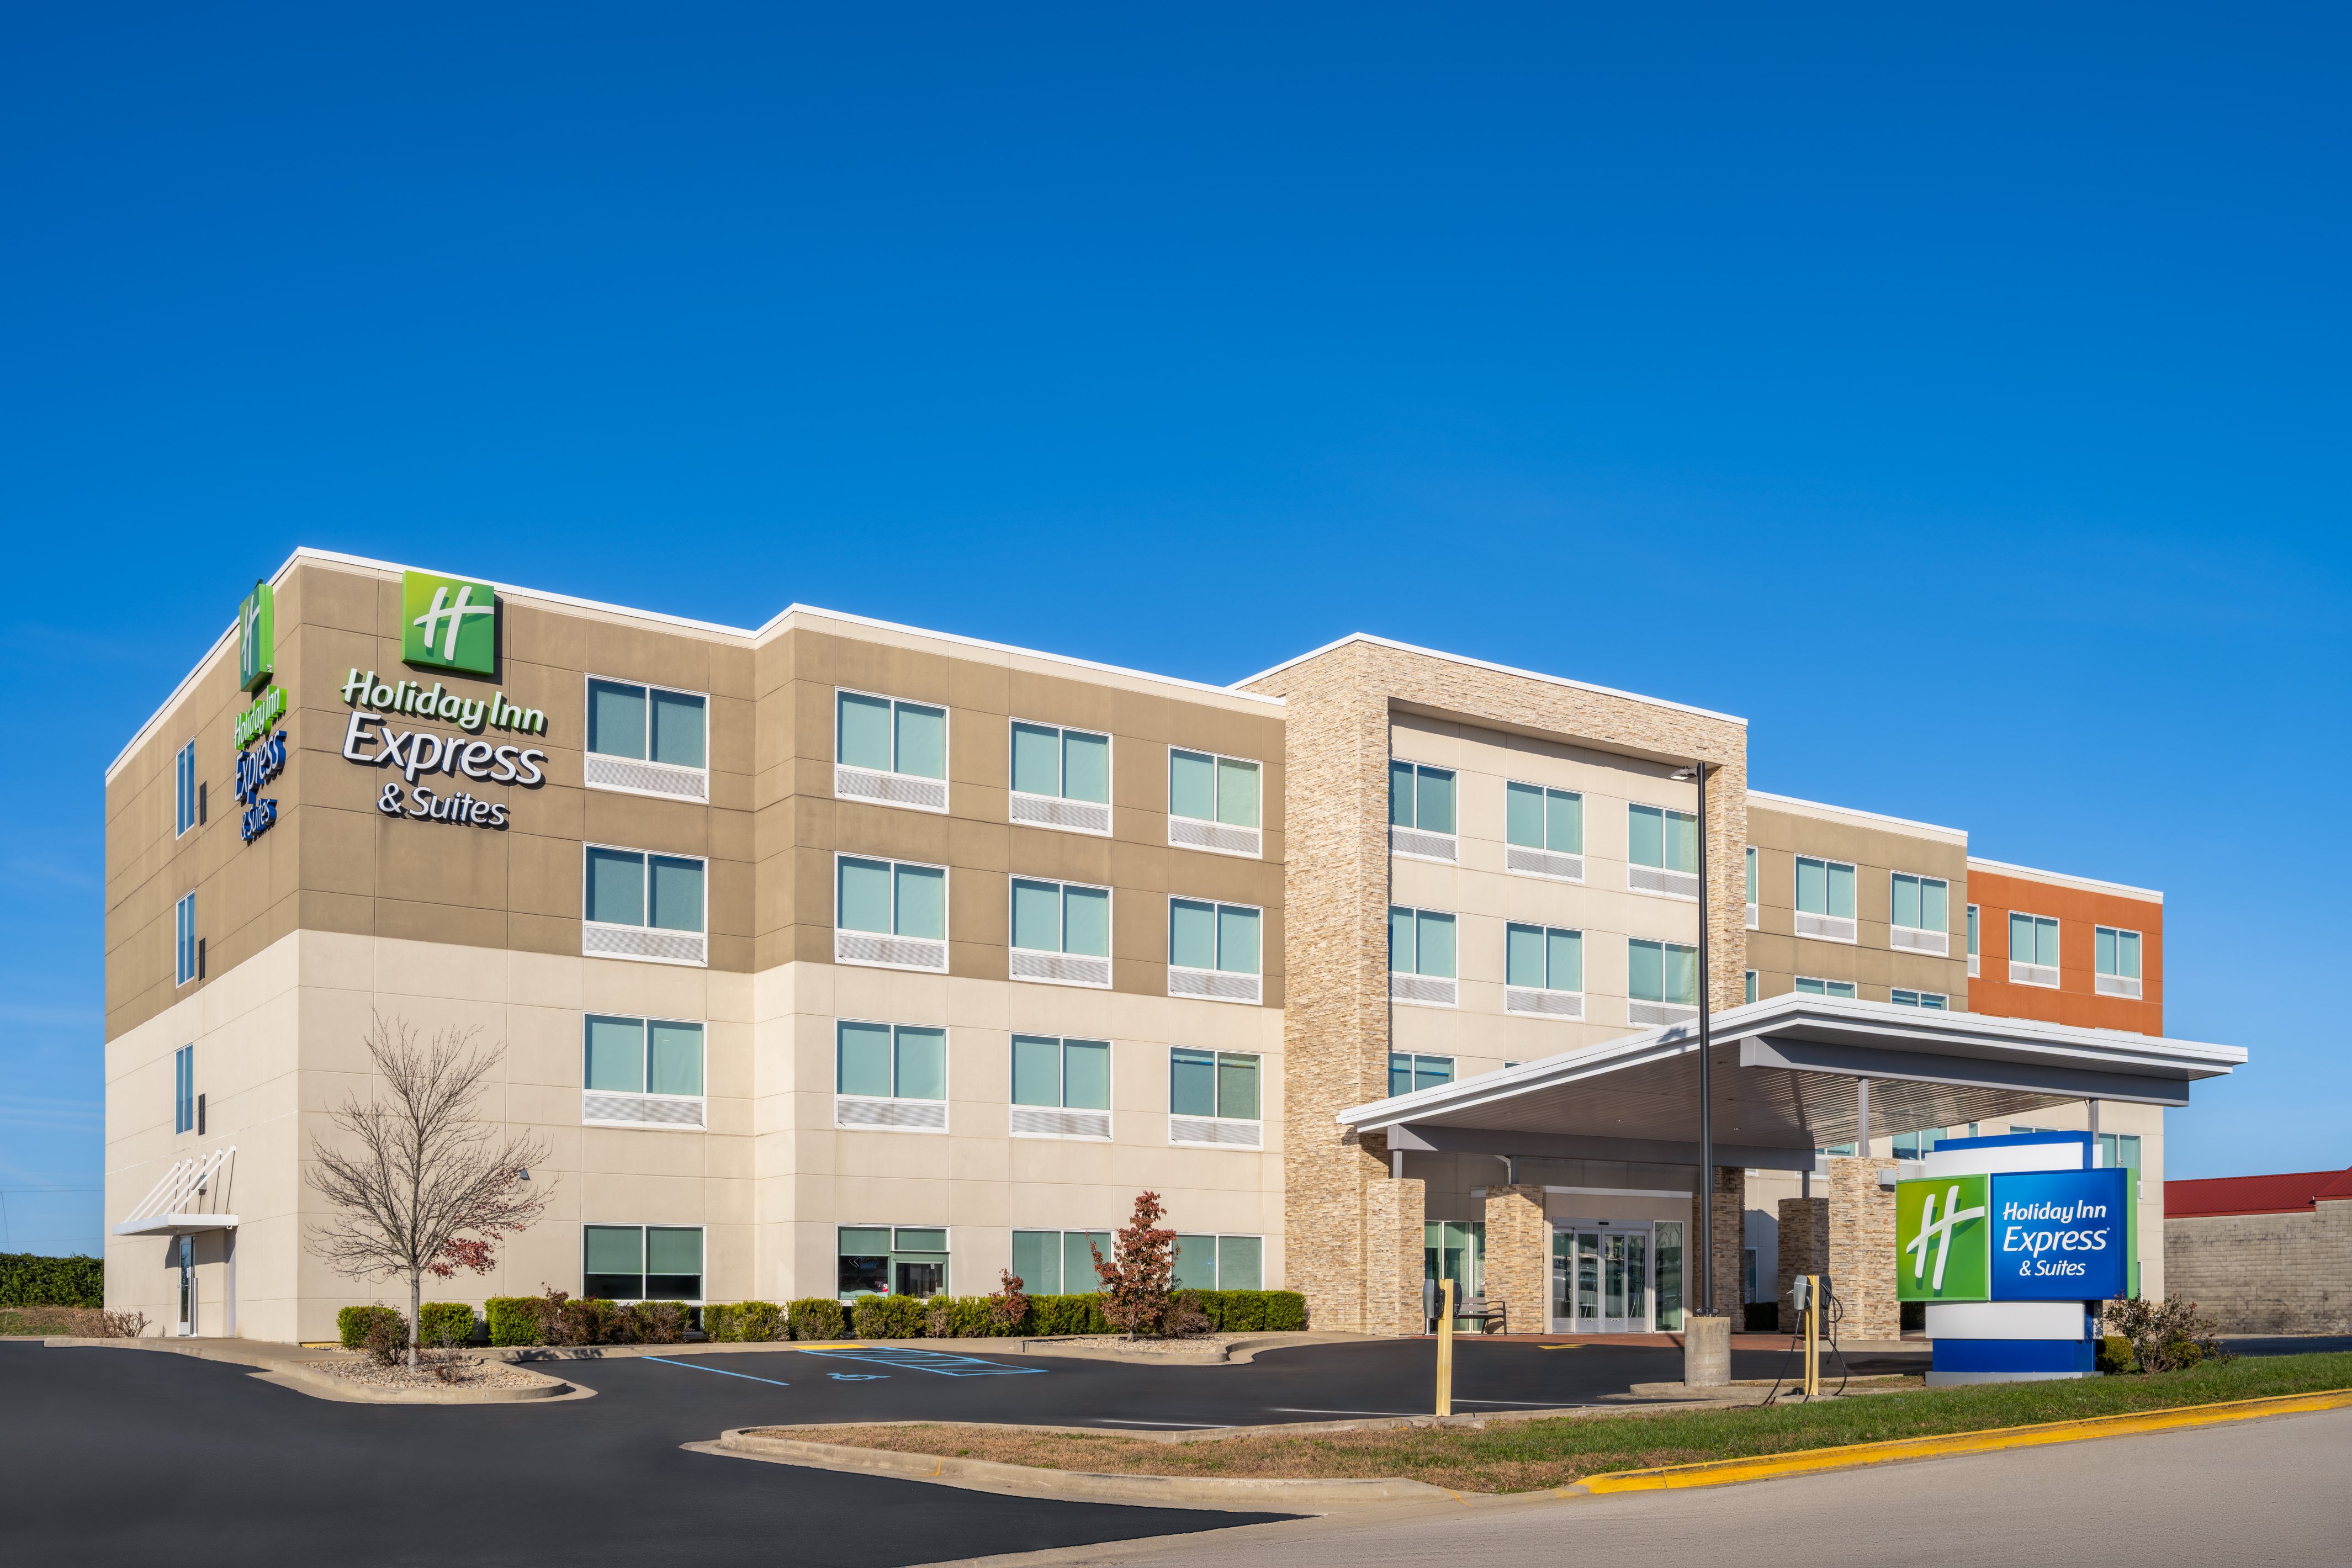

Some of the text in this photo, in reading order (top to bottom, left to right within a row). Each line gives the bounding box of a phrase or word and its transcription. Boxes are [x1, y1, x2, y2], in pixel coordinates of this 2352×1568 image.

[234, 685, 284, 749] Holiday Inn
[341, 668, 544, 733] Holiday Inn
[235, 730, 285, 804] Express
[342, 711, 544, 785] Express
[241, 798, 275, 841] & Suites
[378, 782, 507, 825] & Suites
[2003, 1200, 2107, 1224] Holiday Inn
[2019, 1260, 2086, 1276] & Suites
